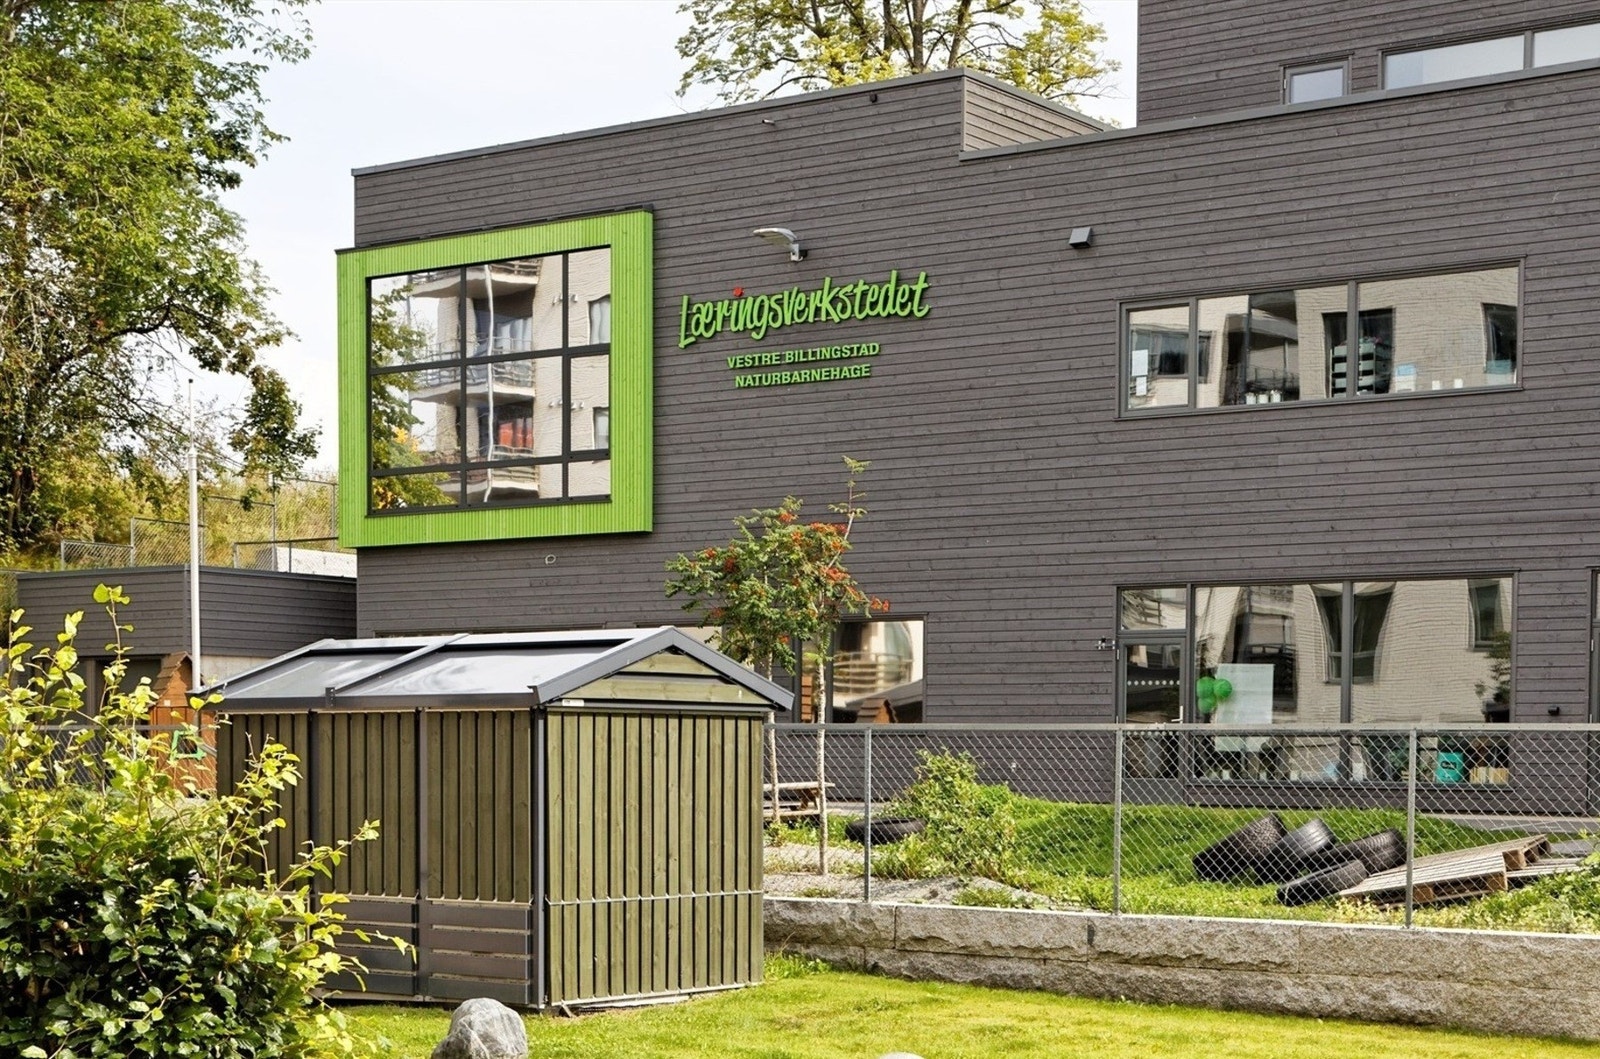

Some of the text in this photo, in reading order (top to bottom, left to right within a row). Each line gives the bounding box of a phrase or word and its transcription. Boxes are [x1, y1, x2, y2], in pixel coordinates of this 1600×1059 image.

[727, 342, 880, 369] VESTRE BILLINGSTAD
[735, 364, 871, 387] NATURBARNEHAGE
